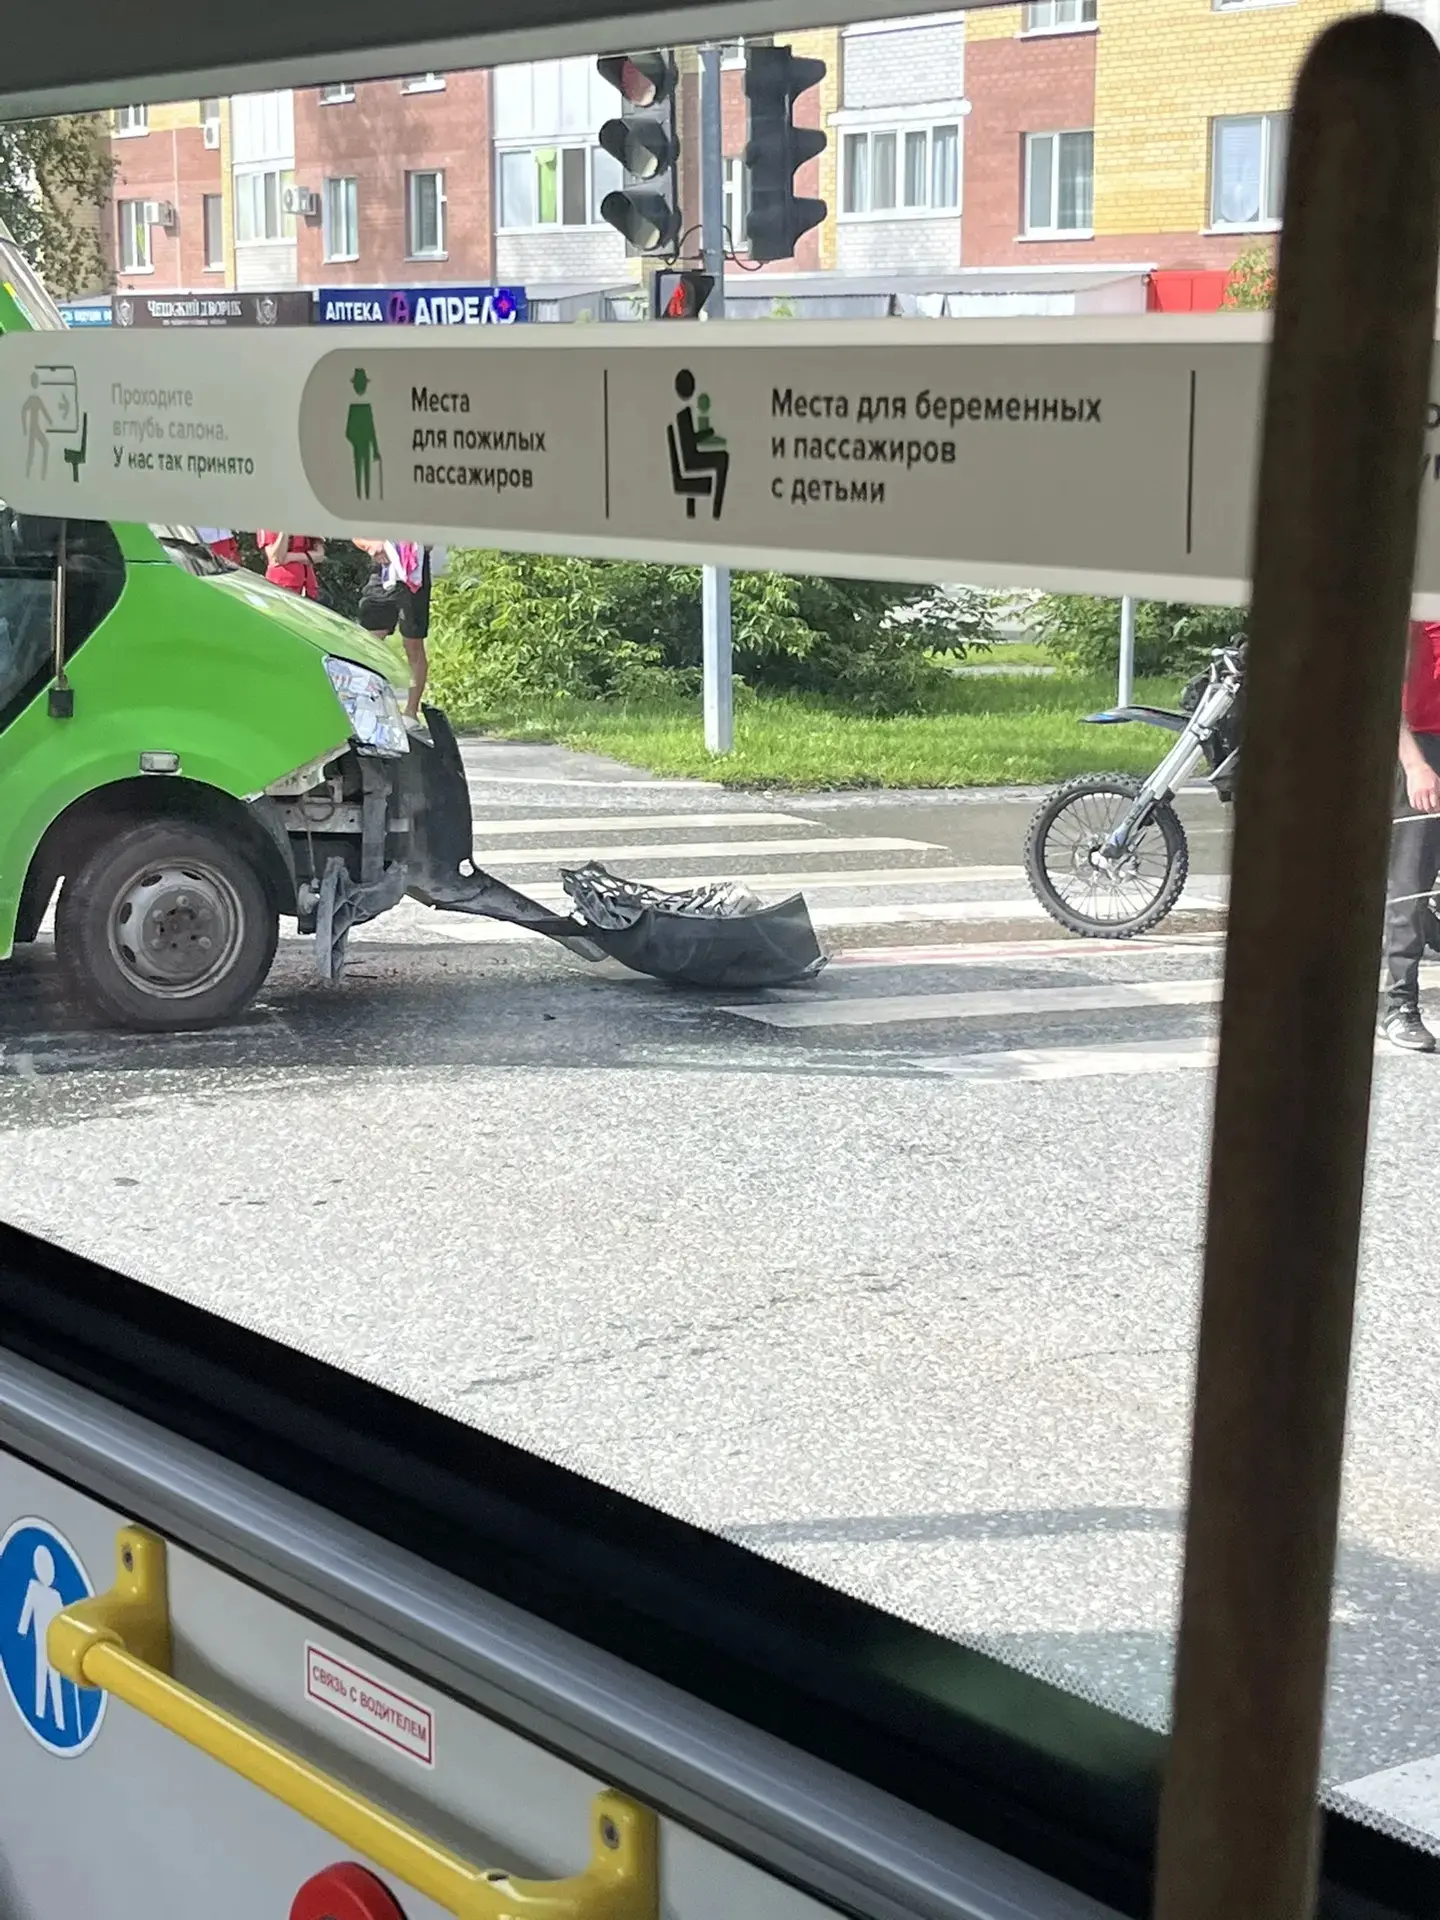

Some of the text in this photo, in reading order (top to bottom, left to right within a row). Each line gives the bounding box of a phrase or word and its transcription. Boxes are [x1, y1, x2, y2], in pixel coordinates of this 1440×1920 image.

[325, 302, 383, 321] АПТЕКА
[111, 382, 194, 411] Проходите
[411, 386, 471, 413] Места
[771, 388, 1102, 429] Места для беременных
[112, 416, 229, 444] вглубь салона.
[412, 428, 547, 452] для пожилых
[113, 445, 255, 479] У нас так принято
[771, 436, 957, 471] и пассажиров
[413, 464, 534, 494] пассажиров
[771, 476, 886, 505] с детьми
[312, 1665, 427, 1743] СВЯЗЬ С ВОДИТЕЛЕМ
